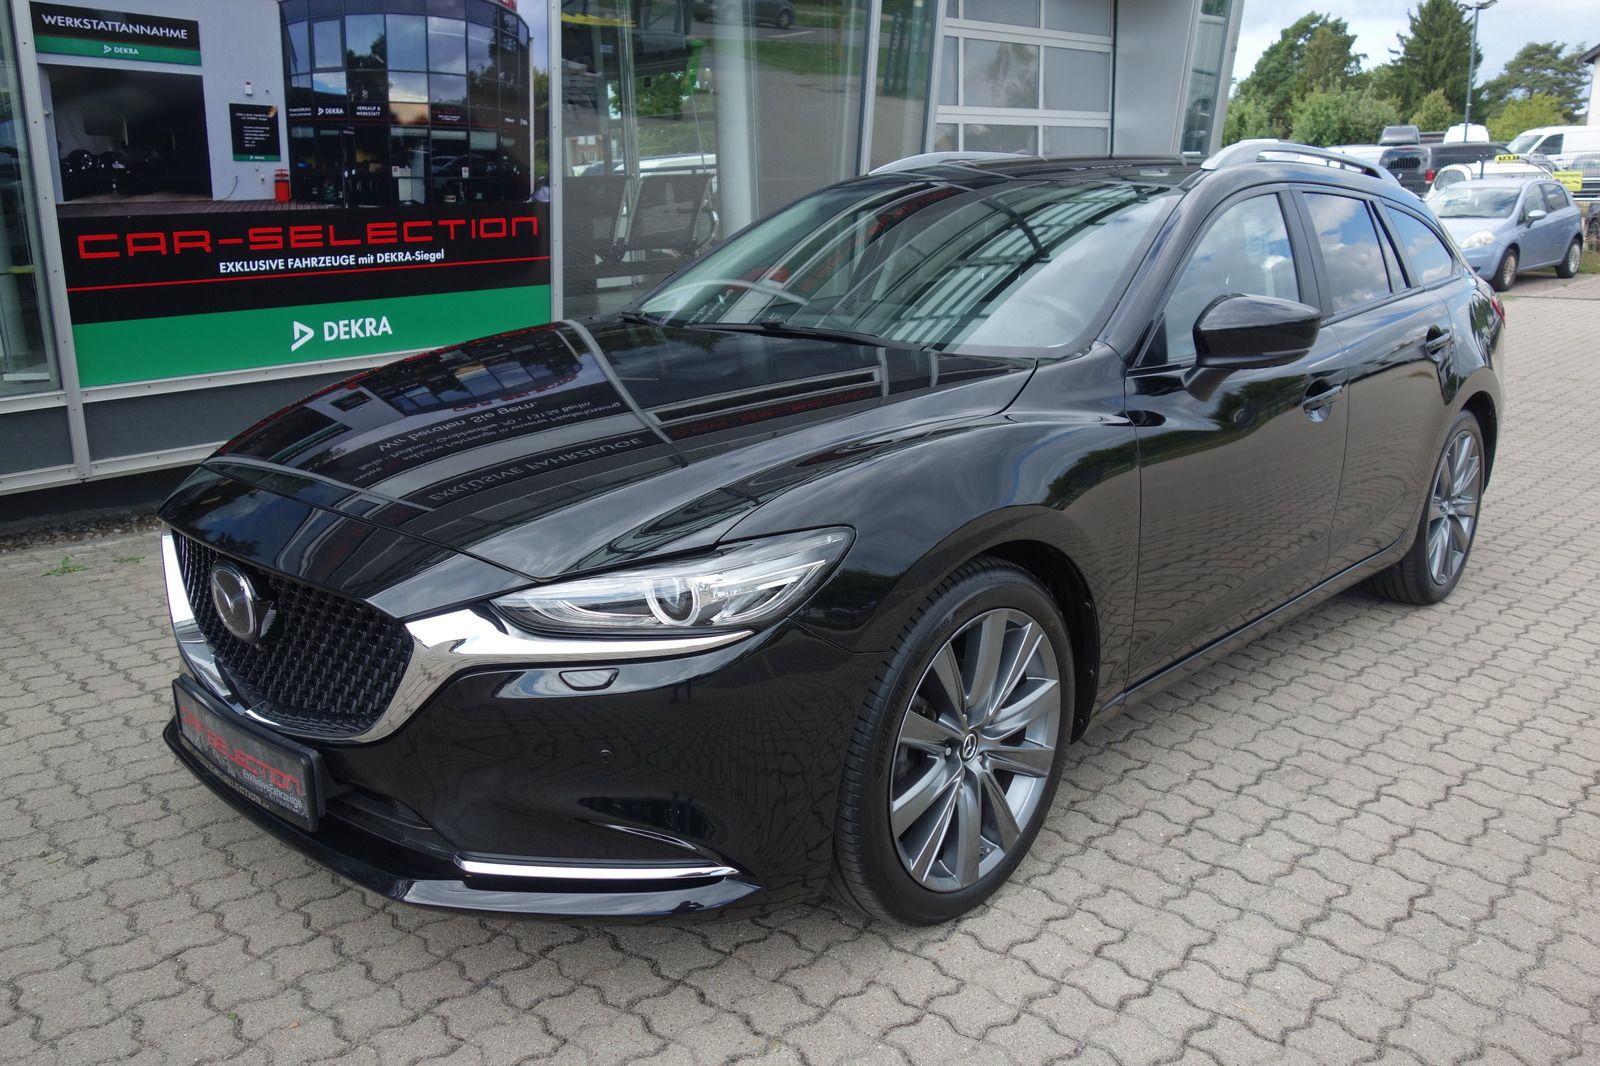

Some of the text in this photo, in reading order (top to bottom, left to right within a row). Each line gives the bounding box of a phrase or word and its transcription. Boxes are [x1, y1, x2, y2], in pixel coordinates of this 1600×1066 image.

[42, 14, 188, 40] WERKSTATTANNAHME
[113, 46, 139, 55] DEKRA
[78, 216, 538, 259] CAR-SELECTION
[219, 249, 445, 274] EXKLUSIVE FAHRZEUGE mit DEKRA-Siegel
[323, 315, 393, 342] DEKRA
